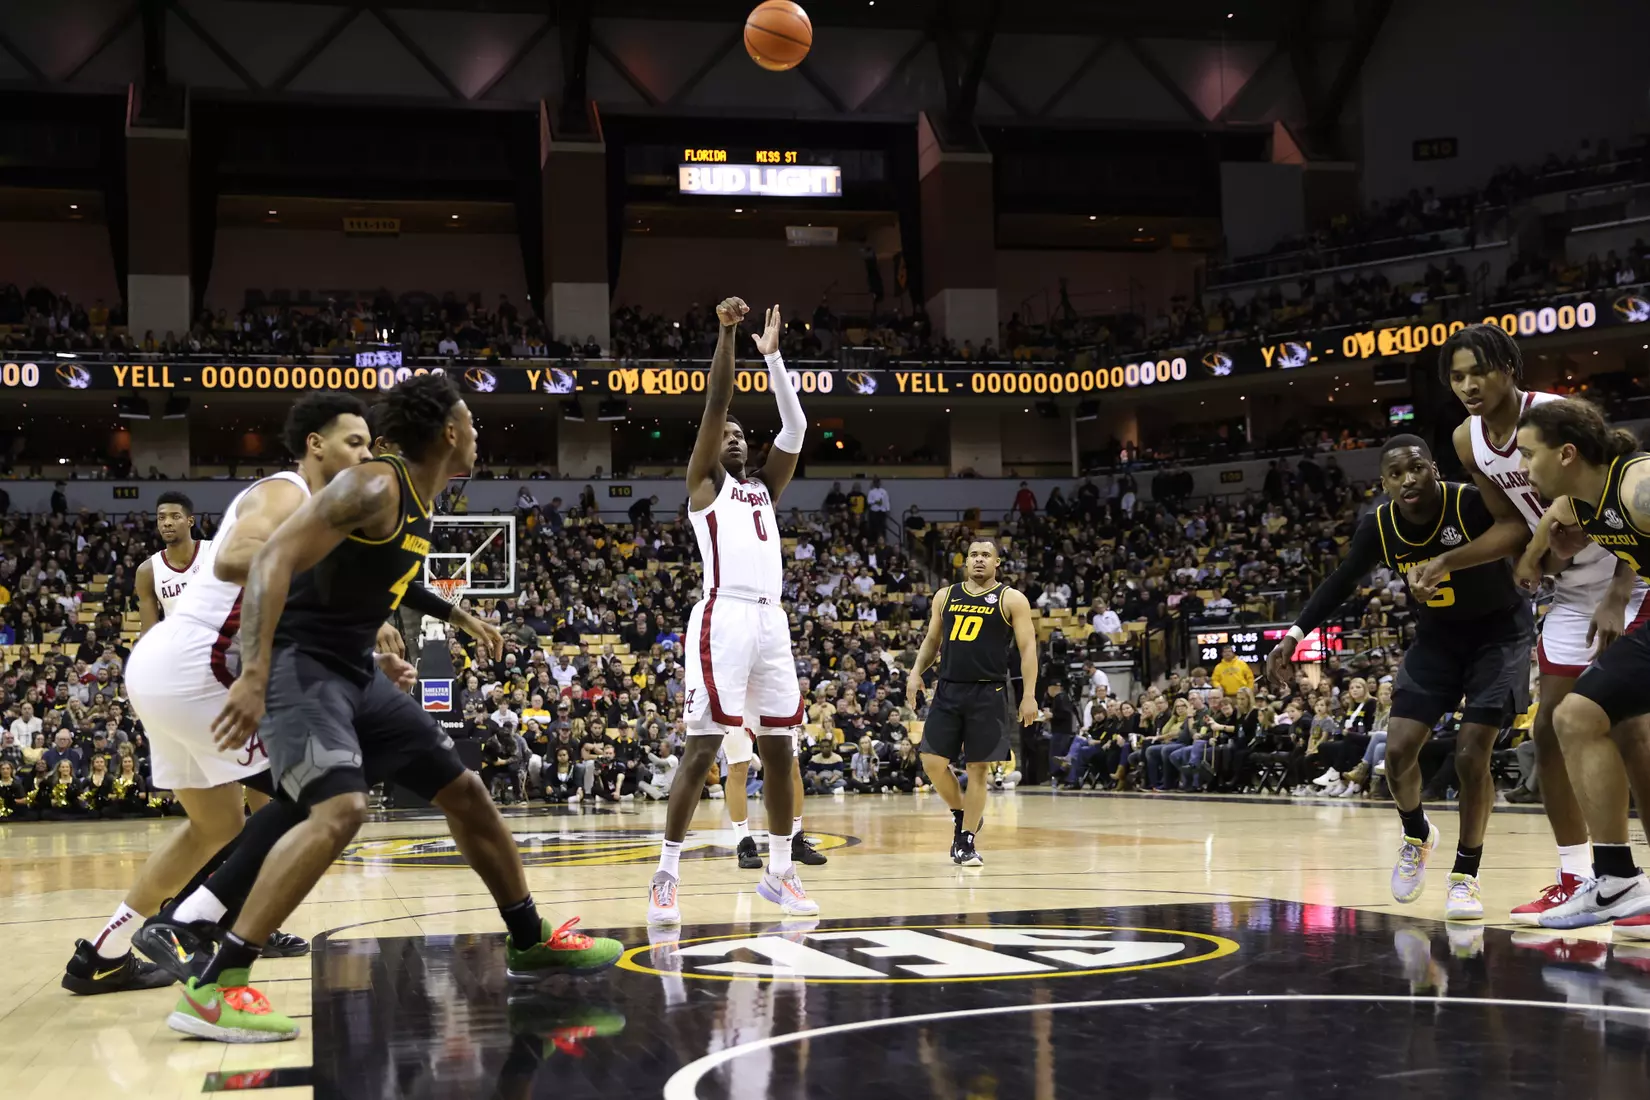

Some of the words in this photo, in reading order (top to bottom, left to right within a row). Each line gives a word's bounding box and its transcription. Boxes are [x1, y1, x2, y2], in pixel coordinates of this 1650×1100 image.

[685, 149, 727, 162] FLORIDA
[785, 151, 797, 163] ST
[679, 166, 746, 192] BUD
[750, 168, 841, 193] LIGHT
[113, 365, 175, 387] YELL
[896, 372, 949, 392] YELL
[115, 488, 137, 497] 111
[611, 487, 631, 496] 110
[753, 510, 767, 541] 0
[388, 560, 421, 610] 4
[948, 604, 995, 615] MIZZOU
[949, 615, 983, 642] 10
[1202, 648, 1218, 660] 28
